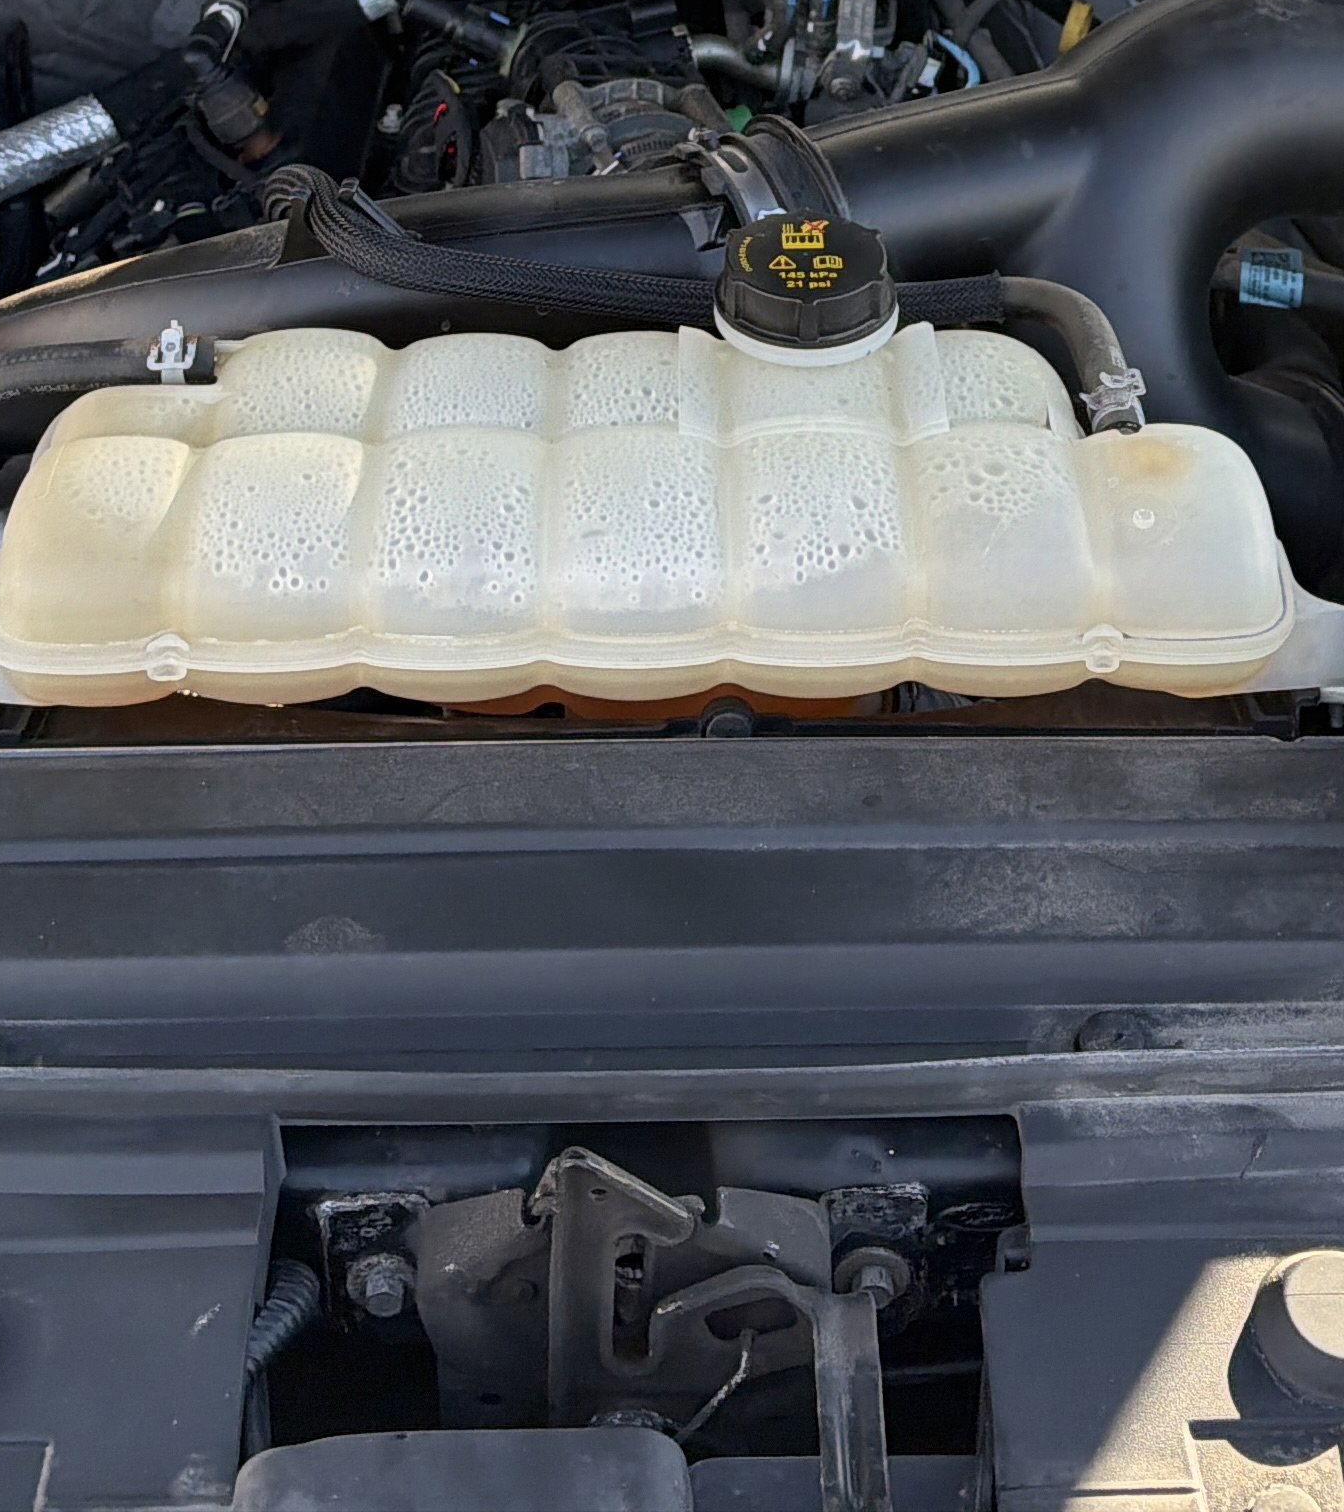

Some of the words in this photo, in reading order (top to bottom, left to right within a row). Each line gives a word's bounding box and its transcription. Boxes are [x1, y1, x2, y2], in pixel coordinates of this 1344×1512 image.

[779, 271, 806, 279] 145
[809, 271, 838, 279] kPa
[786, 280, 804, 288] 21
[808, 280, 831, 289] psi
